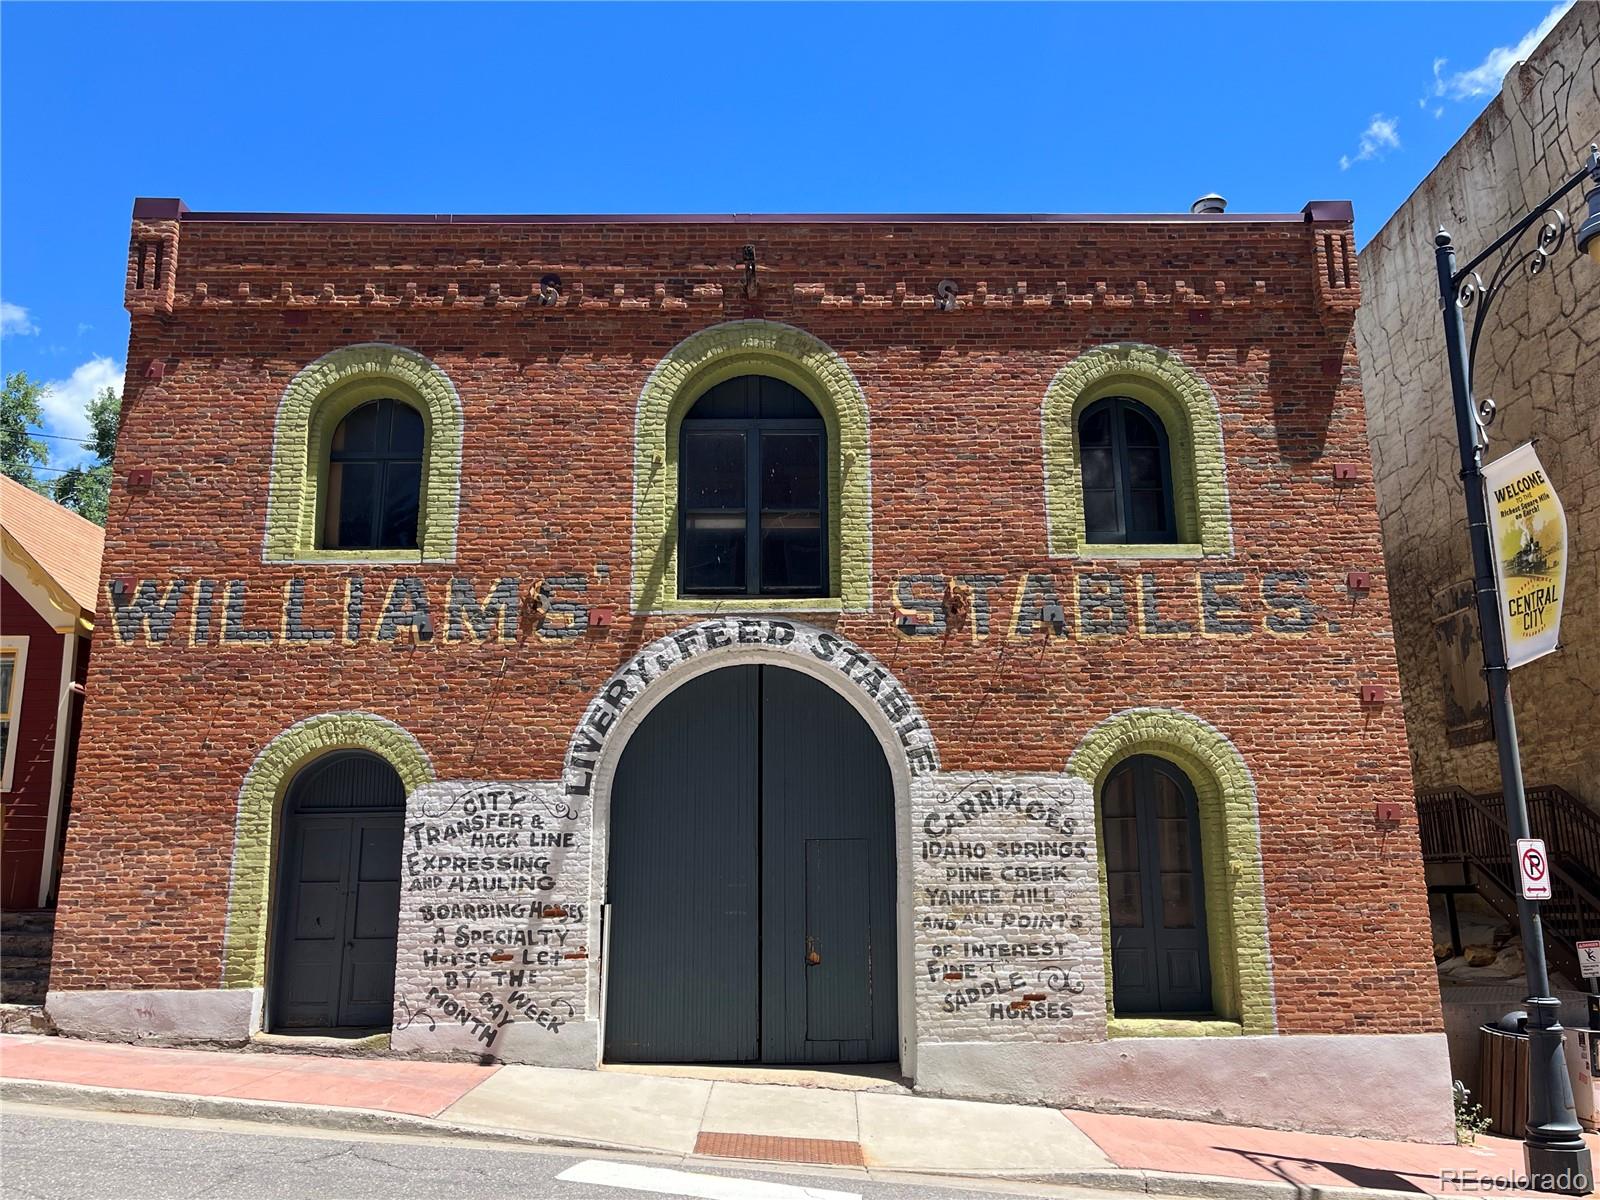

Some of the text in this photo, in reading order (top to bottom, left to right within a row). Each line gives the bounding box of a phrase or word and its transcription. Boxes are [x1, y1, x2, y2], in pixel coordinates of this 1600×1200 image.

[1494, 470, 1545, 503] WELCOME
[1500, 492, 1550, 518] Richest Square Mile
[1508, 585, 1558, 617] CENTRAL
[1523, 606, 1545, 631] CITY
[566, 619, 937, 796] LIVERY & FEED STABLE
[464, 791, 526, 816] CITY
[924, 787, 1078, 838] CARRIAGES
[409, 813, 544, 850] TRANSFER &
[471, 833, 519, 848] HACK
[922, 841, 1088, 860] IDAHO SPRINGS
[407, 852, 550, 876] EXPRESSING
[946, 865, 1070, 882] PINE CREEK
[408, 876, 556, 892] AND HAULING
[925, 887, 1056, 906] YANKEE HILL
[419, 901, 585, 923] BOARDING HSES
[922, 916, 957, 931] AND
[962, 912, 994, 925] ALL
[434, 925, 570, 948] A SPECIALTY
[931, 942, 1067, 958] OF INTEREST
[444, 969, 537, 990] BY THE
[943, 971, 1027, 1013] SADDLE
[425, 987, 497, 1048] MONTH
[479, 992, 515, 1028] DAY
[507, 990, 566, 1034] WEEK
[990, 1001, 1074, 1020] HORSES
